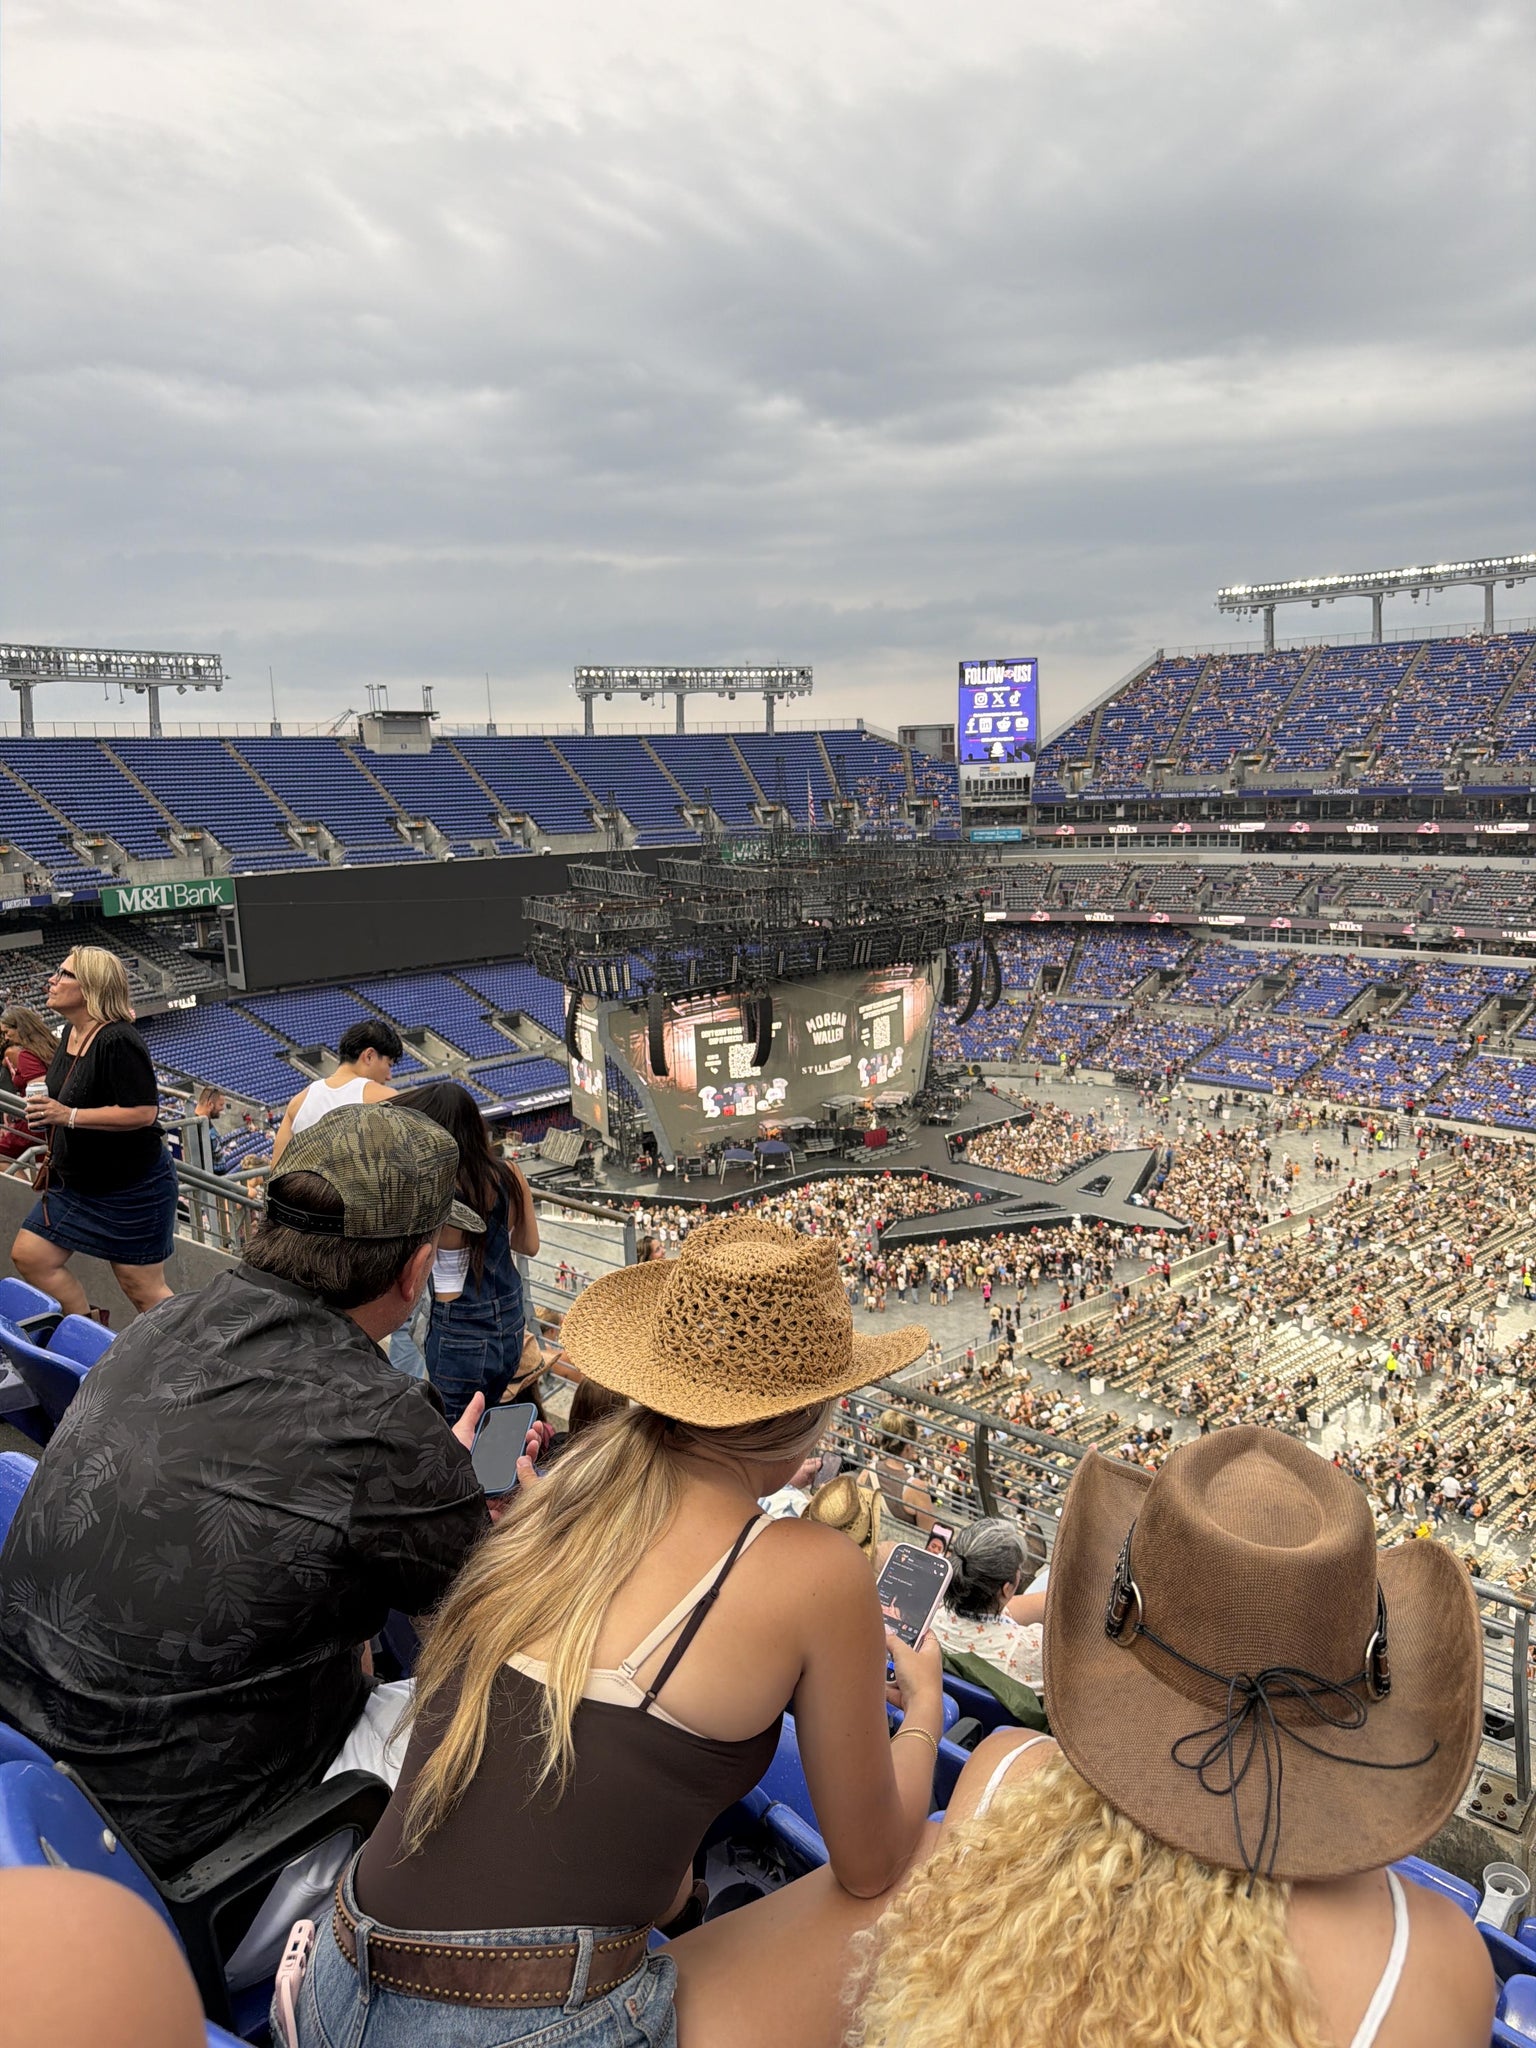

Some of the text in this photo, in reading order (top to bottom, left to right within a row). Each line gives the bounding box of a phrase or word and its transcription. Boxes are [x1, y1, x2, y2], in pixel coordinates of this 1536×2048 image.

[965, 664, 1032, 685] FOLLOW US!
[116, 881, 224, 914] M&T Bank
[805, 1011, 847, 1034] MORGAN
[812, 1027, 844, 1046] WALLEN
